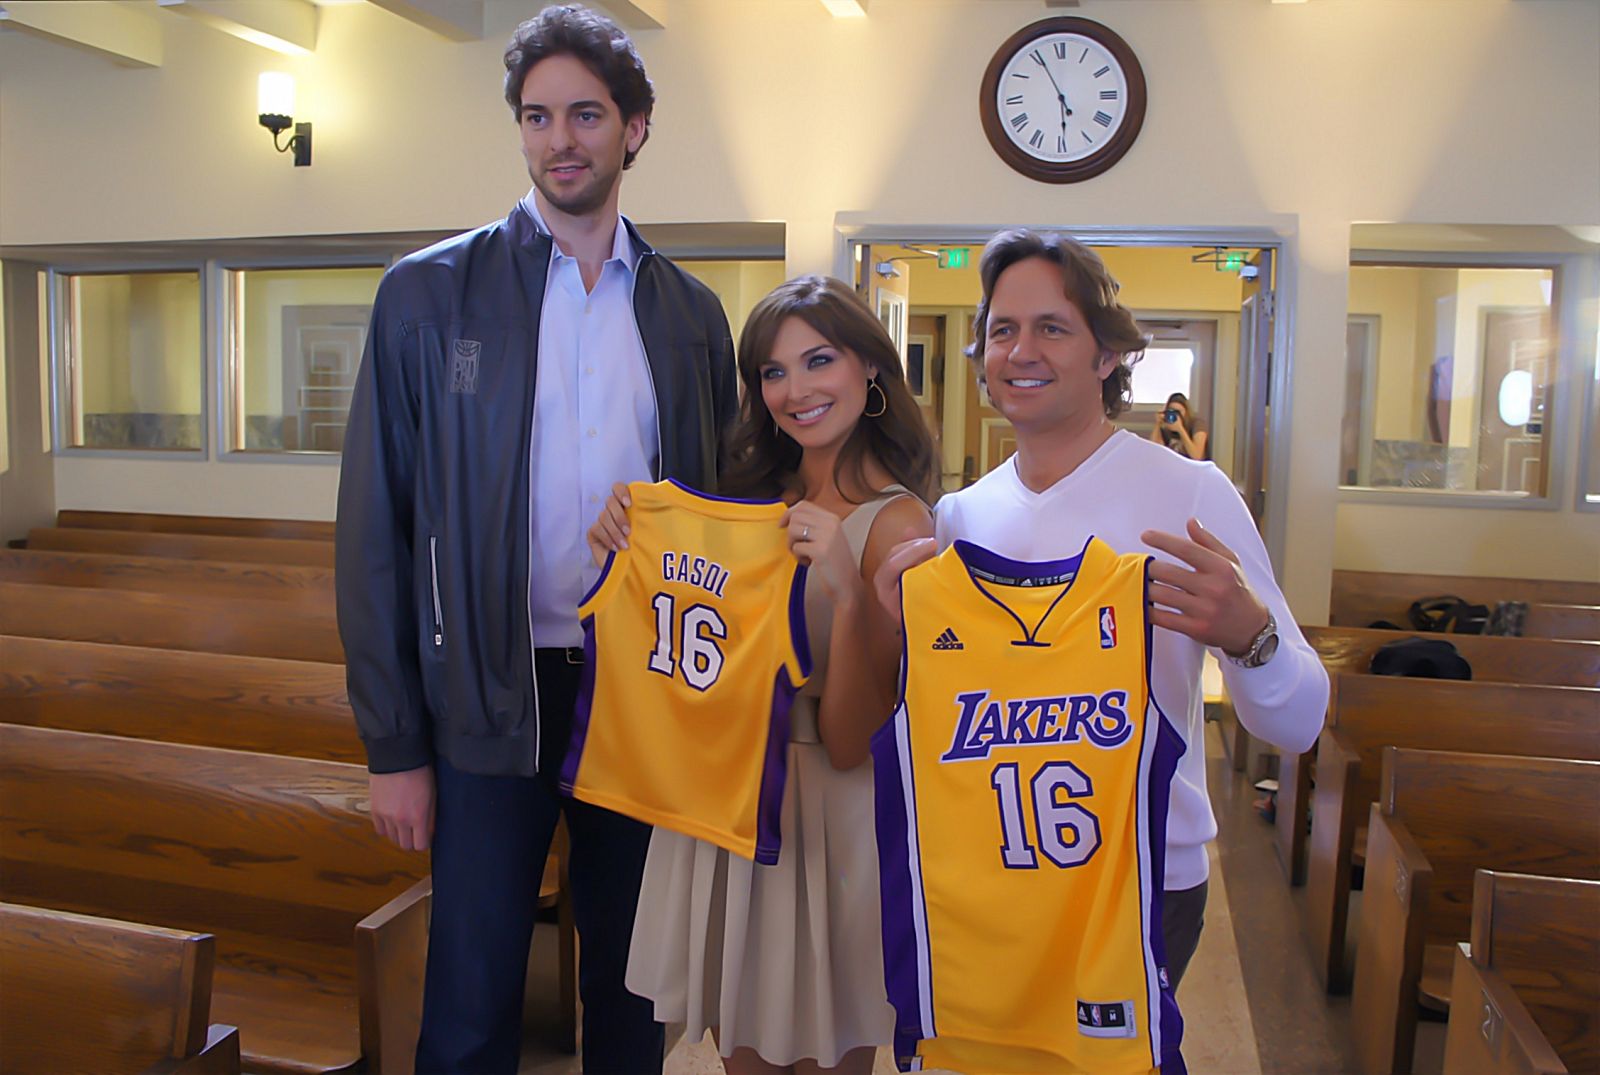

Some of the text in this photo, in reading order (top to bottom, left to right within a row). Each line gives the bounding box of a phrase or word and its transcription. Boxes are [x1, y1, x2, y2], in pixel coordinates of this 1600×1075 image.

[938, 248, 969, 268] EXIT
[662, 552, 730, 599] GASOL
[648, 591, 727, 692] 16
[932, 642, 964, 650] adidas
[939, 689, 1134, 763] LAKERS
[991, 761, 1102, 869] 16
